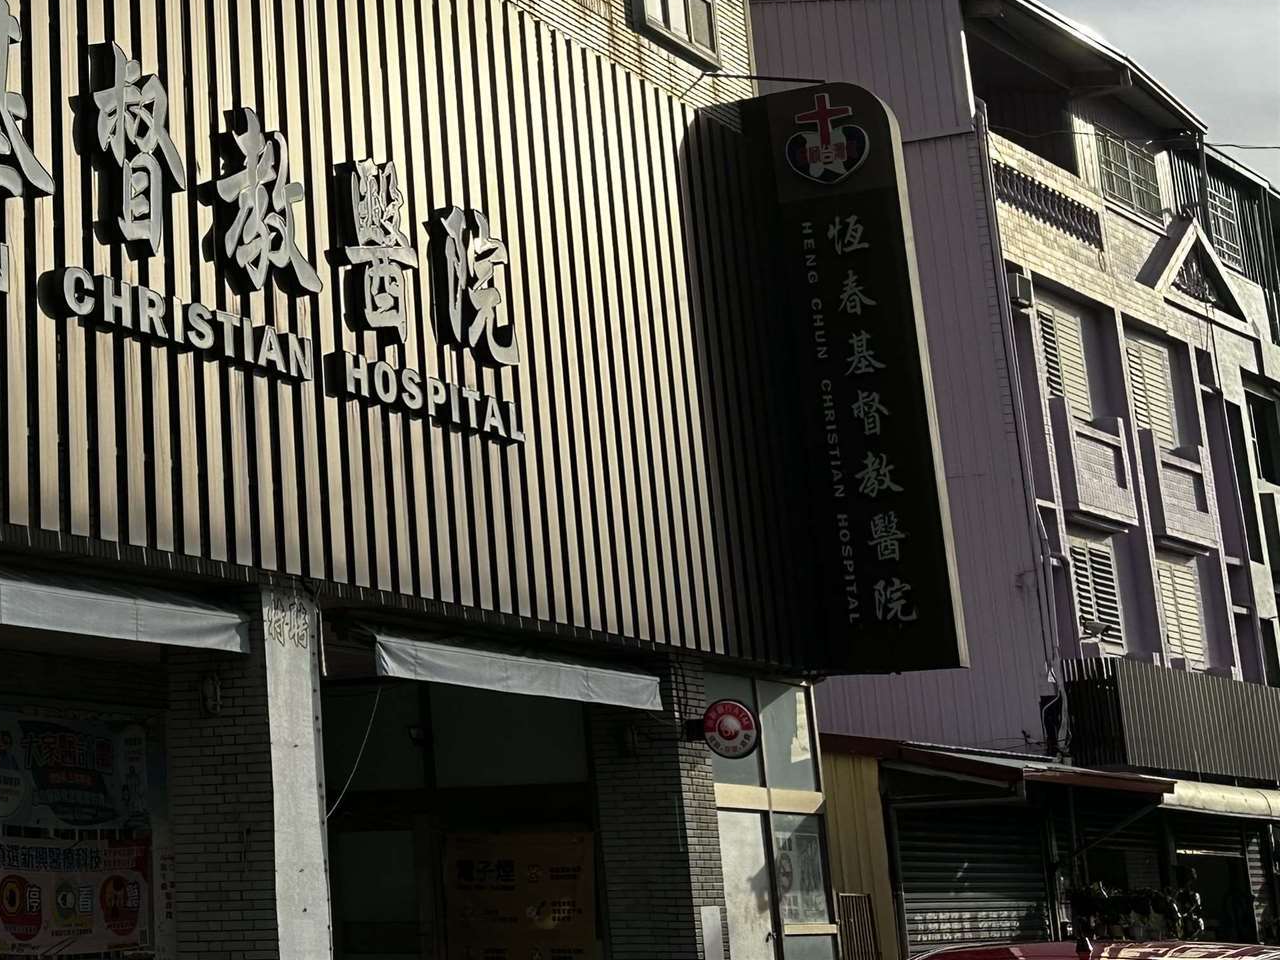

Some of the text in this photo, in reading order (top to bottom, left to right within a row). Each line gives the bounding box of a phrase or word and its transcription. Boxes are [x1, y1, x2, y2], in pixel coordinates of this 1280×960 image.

[63, 267, 313, 381] CHRISTIAN
[346, 353, 526, 442] HOSPITAL
[801, 221, 860, 624] HENG CHUN CHRISTIAN HOSPITAL
[827, 215, 919, 621] 恆春基督教醫院
